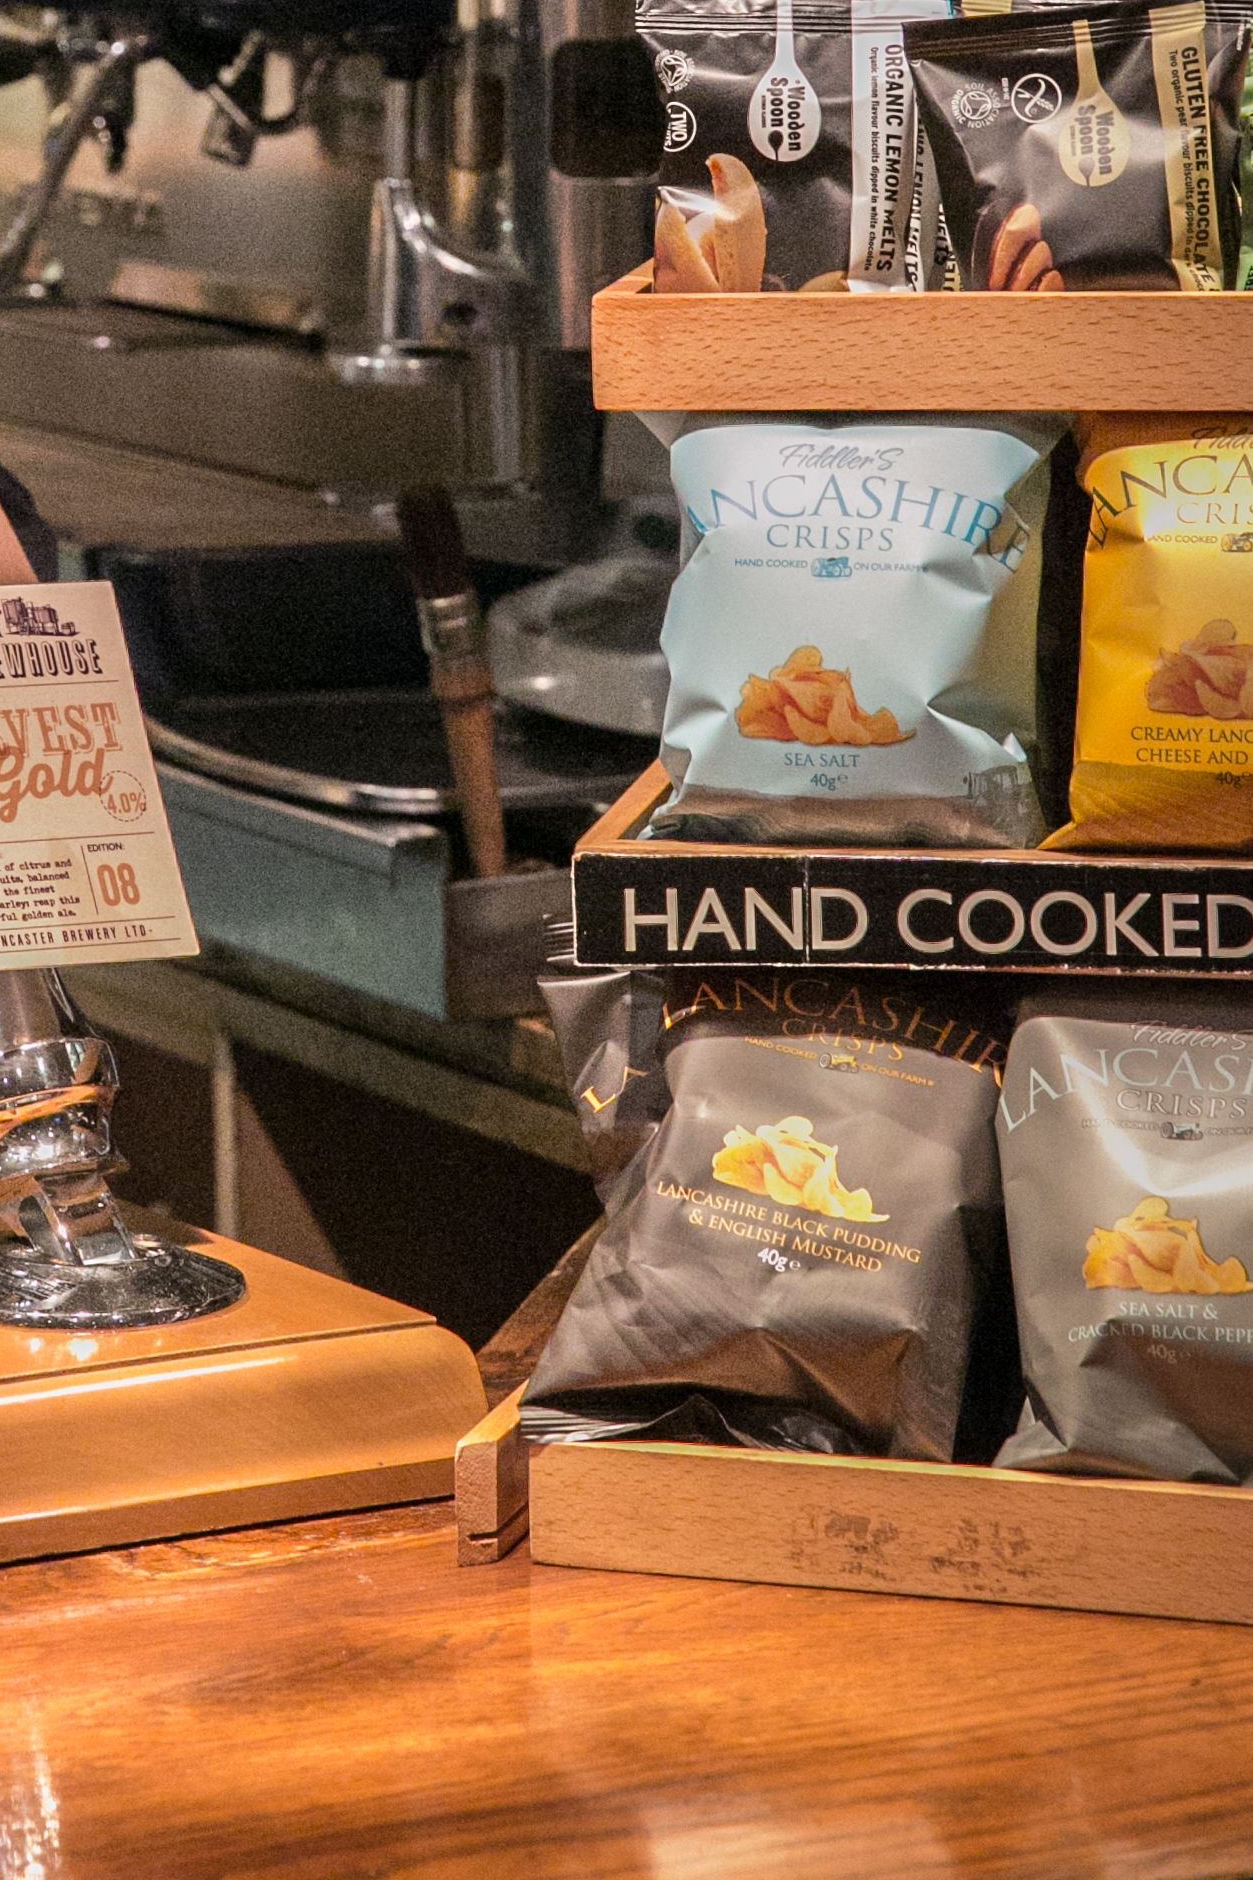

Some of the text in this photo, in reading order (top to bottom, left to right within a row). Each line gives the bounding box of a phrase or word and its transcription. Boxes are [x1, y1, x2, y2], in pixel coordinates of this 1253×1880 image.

[869, 47, 878, 72] Organic
[1169, 50, 1179, 67] Two
[965, 82, 985, 91] SOIL
[1171, 69, 1185, 105] organic
[767, 77, 788, 127] Spoon
[871, 100, 880, 127] flavour
[951, 89, 966, 124] ORGANIC
[670, 111, 687, 142] TWO
[787, 86, 805, 151] Wooden
[1076, 104, 1096, 155] Spoon
[1174, 106, 1188, 127] pear
[871, 131, 880, 163] biscuits
[1096, 110, 1115, 175] Wooden
[876, 44, 904, 271] ORGANIC LEMON MELTS
[1181, 46, 1215, 283] GLUTEN FREE CHOCOLATE
[870, 165, 881, 194] dipped
[1183, 162, 1195, 200] biscuits
[869, 206, 877, 229] white
[1183, 201, 1196, 234] dipped
[865, 231, 877, 271] chocolate
[686, 474, 1032, 573] NCASHIRE
[766, 524, 894, 551] CRISPS
[1147, 535, 1218, 544] AND COOKED
[734, 558, 763, 568] HAND
[766, 559, 808, 569] COOKED
[853, 562, 869, 571] ON
[870, 563, 892, 572] OUR
[1130, 726, 1203, 743] CREAMY
[784, 752, 860, 768] SEA SALT
[1136, 747, 1249, 765] CHEESE AND
[810, 773, 836, 791] 40g
[1216, 771, 1241, 789] 40g
[107, 790, 147, 814] 4.0%
[4, 862, 15, 872] of
[19, 860, 51, 871] citrus
[54, 859, 73, 869] and
[27, 871, 70, 882] balanced
[3, 886, 20, 896] the
[23, 885, 55, 895] finest
[96, 862, 141, 908] 08
[33, 899, 56, 909] reap
[59, 895, 80, 906] this
[21, 910, 54, 922] golden
[622, 885, 1253, 960] HAND COOKED
[62, 927, 119, 943] BREWERY
[782, 1018, 904, 1062] CRISPS
[746, 1036, 927, 1085] HAND COOKED ON OUR FARM
[1116, 1088, 1246, 1119] CRISPS
[657, 1181, 922, 1264] LANCASHIRE BLACK PUDDING
[688, 1208, 883, 1272] & ENGLISH MUSTARD
[757, 1247, 787, 1273] 40g
[1119, 1301, 1218, 1320] SEA SALT &
[1068, 1321, 1145, 1343] CRACKED
[1151, 1323, 1209, 1342] BLACK
[1146, 1343, 1177, 1364] 40g
